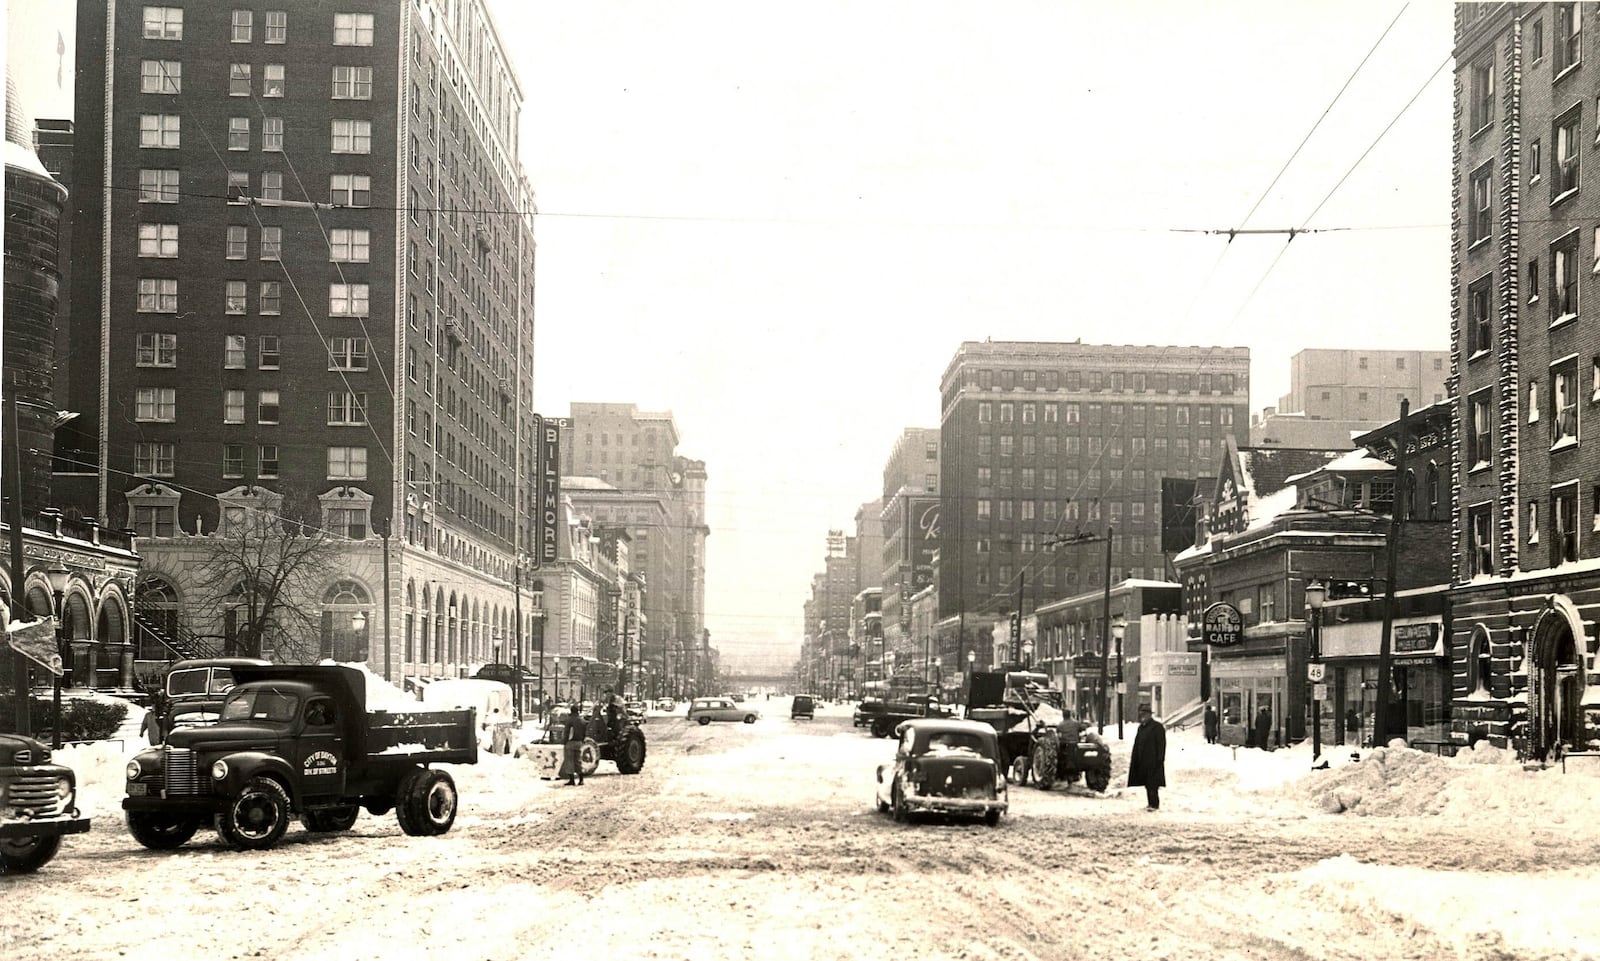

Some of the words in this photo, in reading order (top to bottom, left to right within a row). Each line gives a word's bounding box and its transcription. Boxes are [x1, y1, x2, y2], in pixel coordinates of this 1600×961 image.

[544, 428, 557, 558] BILTMORE
[628, 592, 636, 626] LOAN
[1206, 623, 1240, 632] RAINBO
[1210, 633, 1236, 643] CAFE
[1310, 669, 1321, 677] 48
[304, 754, 315, 767] CITY
[315, 751, 321, 759] OF
[320, 751, 337, 766] DAYTON
